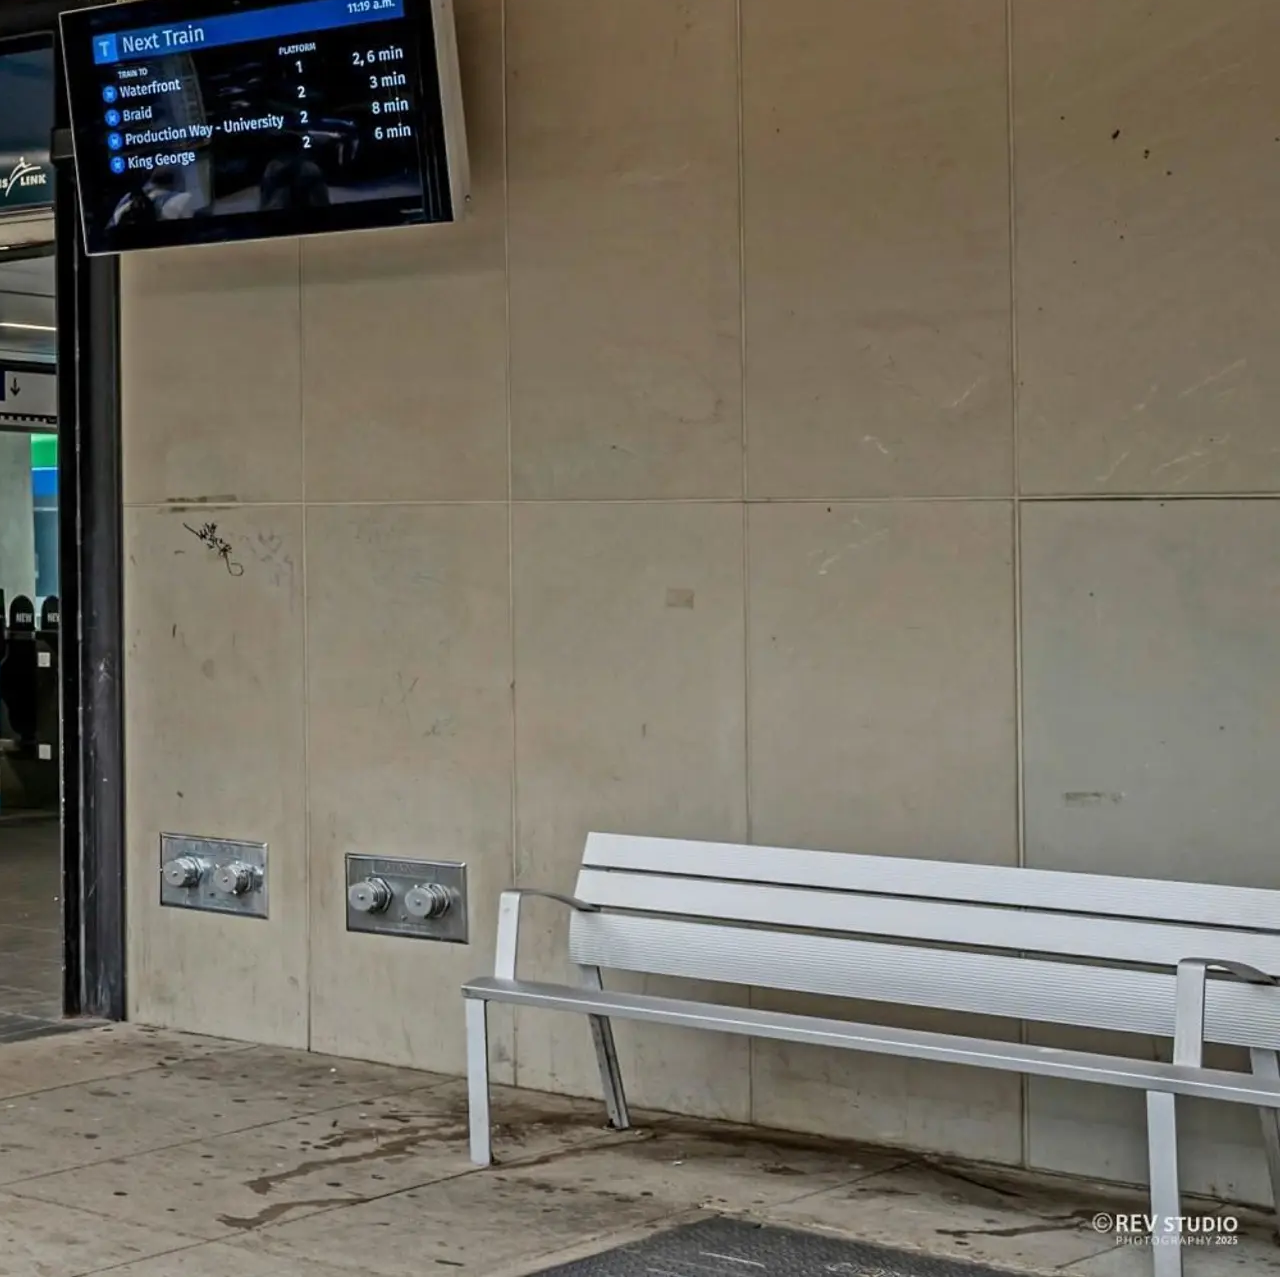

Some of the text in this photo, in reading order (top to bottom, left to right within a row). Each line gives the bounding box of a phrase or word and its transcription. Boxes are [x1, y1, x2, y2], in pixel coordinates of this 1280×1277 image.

[347, 0, 371, 14] 11:19
[122, 24, 205, 53] Next Train
[98, 41, 109, 57] T
[278, 42, 316, 56] PLATFORM
[352, 45, 404, 67] 2, 6 min
[139, 67, 148, 76] TO
[295, 60, 304, 73] 1
[120, 78, 182, 99] Waterfront
[369, 71, 407, 90] 3 min
[297, 85, 307, 99] 2
[123, 106, 153, 122] Braid
[371, 97, 409, 115] 8 min
[300, 110, 309, 124] 2
[125, 127, 187, 146] Production
[189, 123, 214, 138] Way
[223, 113, 285, 134] University
[374, 122, 412, 140] 6 min
[302, 135, 312, 149] 2
[128, 151, 196, 170] King George
[16, 613, 32, 622] NEW
